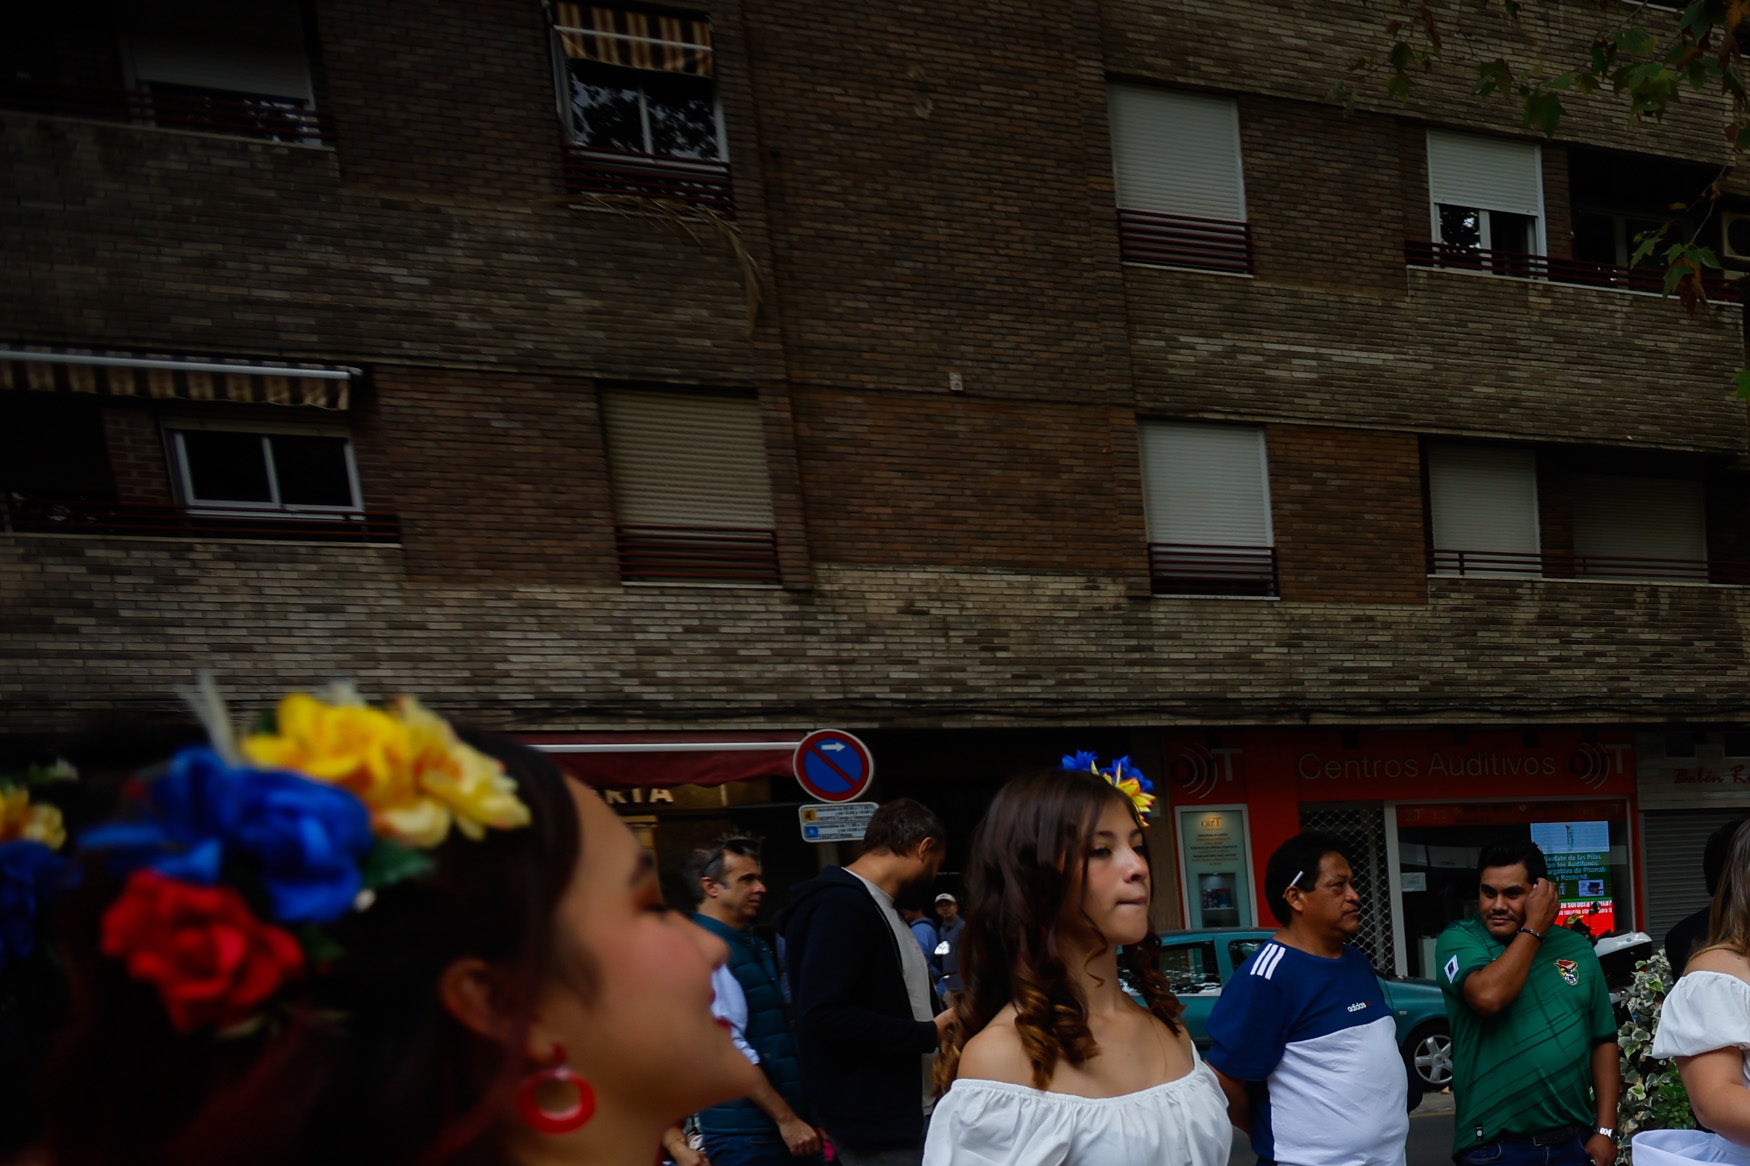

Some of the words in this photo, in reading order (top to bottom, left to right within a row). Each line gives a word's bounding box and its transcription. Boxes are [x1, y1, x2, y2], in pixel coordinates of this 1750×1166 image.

[1298, 753, 1419, 780] Centros
[1428, 752, 1556, 777] Auditivos
[1347, 1002, 1367, 1012] adidas
